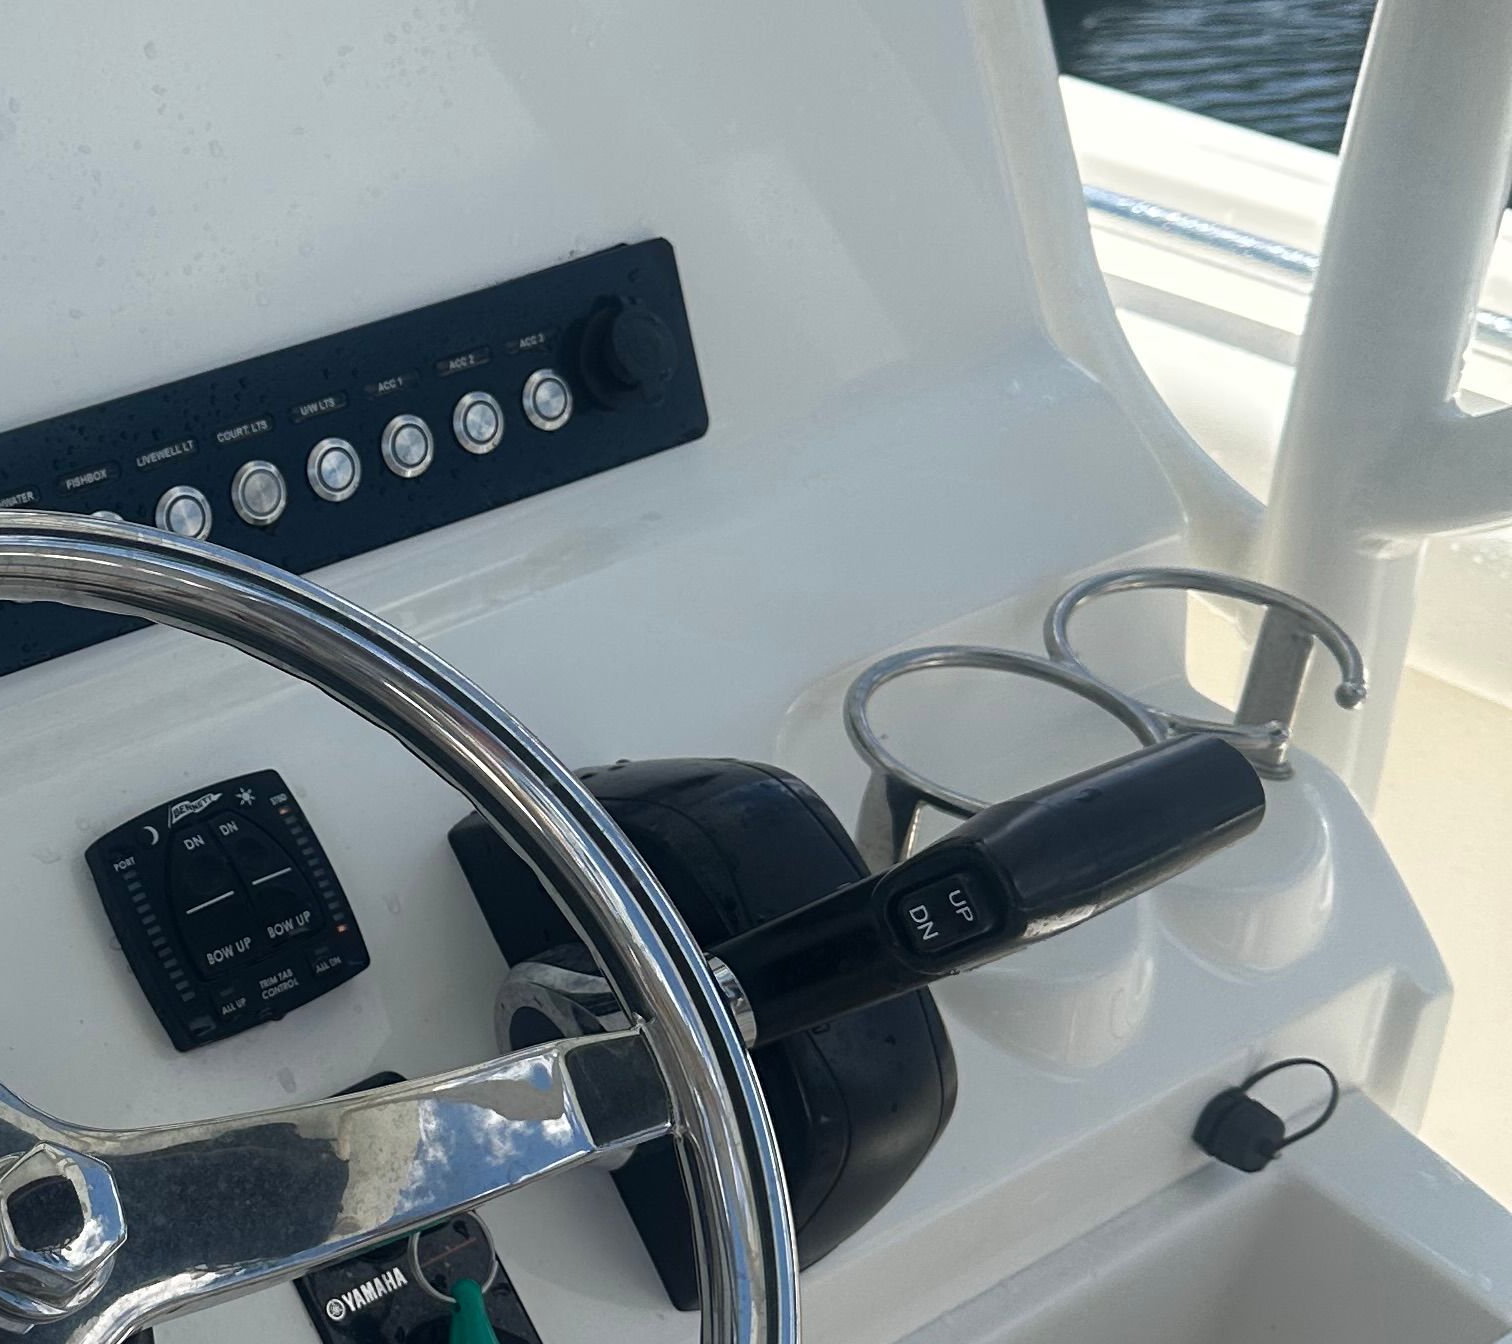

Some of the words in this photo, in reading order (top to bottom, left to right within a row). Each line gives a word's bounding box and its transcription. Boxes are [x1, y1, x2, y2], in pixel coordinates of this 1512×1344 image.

[520, 334, 536, 349] ACC
[449, 355, 467, 370] ACC
[377, 378, 396, 394] ACC
[249, 418, 269, 434] LTS
[136, 442, 180, 468] LIVEWELL
[65, 468, 108, 490] FISHBOX
[219, 821, 238, 837] DN
[184, 834, 206, 851] DN
[113, 856, 136, 872] PORT
[948, 889, 975, 923] UP
[267, 916, 293, 939] BOW
[294, 910, 311, 927] UP
[909, 903, 939, 942] DN
[206, 943, 234, 966] BOW
[237, 936, 252, 954] UP
[261, 978, 300, 1001] CONTROL
[341, 1266, 408, 1313] YAMAHA
